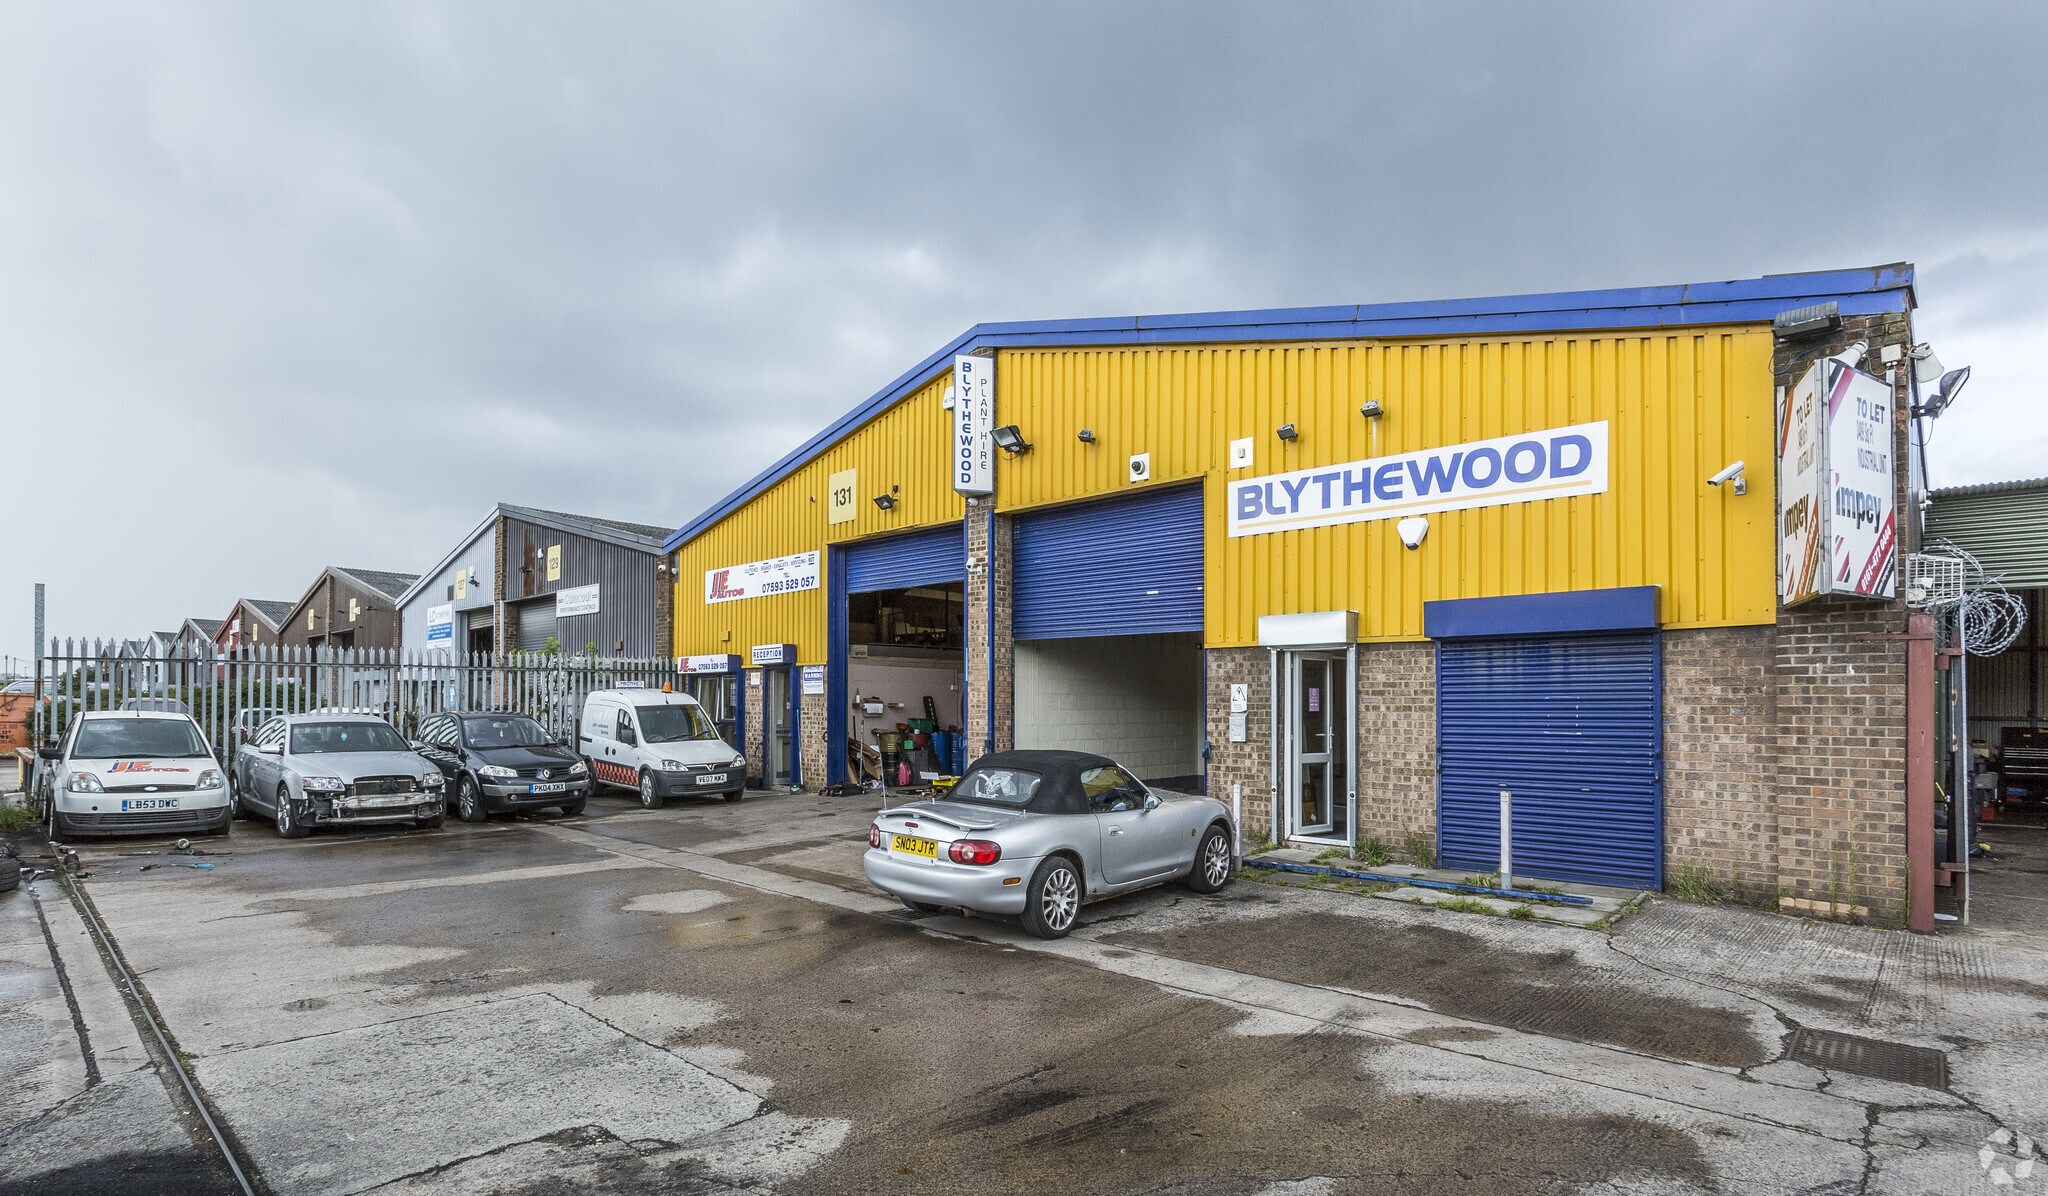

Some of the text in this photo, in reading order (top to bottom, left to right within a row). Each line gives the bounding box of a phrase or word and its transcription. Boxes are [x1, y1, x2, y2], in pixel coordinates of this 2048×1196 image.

[980, 379, 988, 427] PLANT
[1796, 405, 1803, 427] TO
[1803, 391, 1813, 418] LET
[1856, 397, 1885, 424] TO LET
[960, 362, 973, 484] BLYTHEWOOD
[1237, 434, 1592, 521] BLYTHEWOOD
[833, 486, 852, 507] 131
[1835, 486, 1881, 534] impey
[549, 556, 559, 570] 129
[717, 588, 745, 599] AUTOS
[762, 576, 815, 593] 07593 529 057
[753, 649, 782, 658] RECEPTION
[128, 799, 178, 809] LB53 DWC
[895, 836, 935, 855] SN03 JTR
